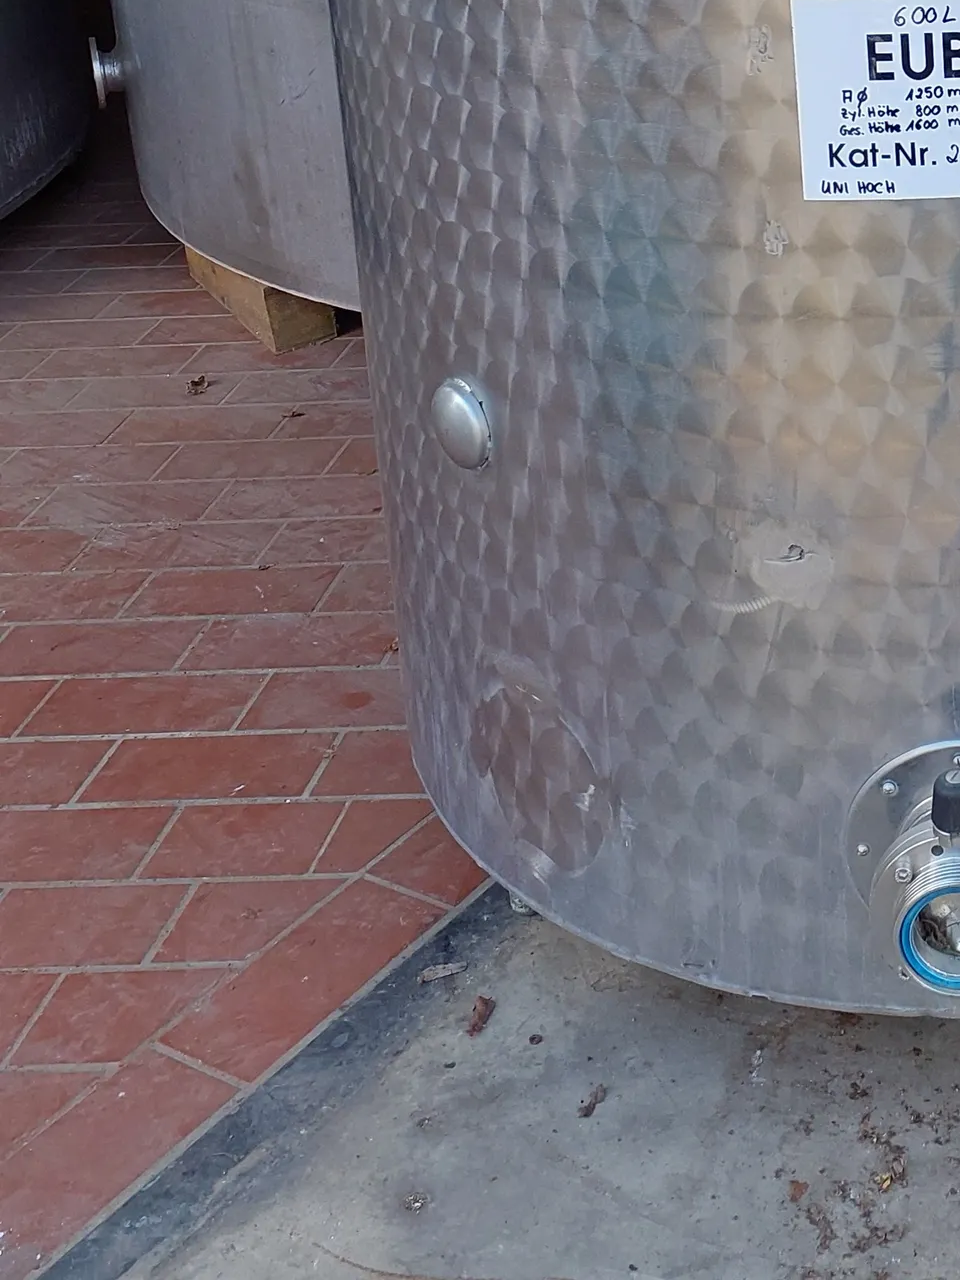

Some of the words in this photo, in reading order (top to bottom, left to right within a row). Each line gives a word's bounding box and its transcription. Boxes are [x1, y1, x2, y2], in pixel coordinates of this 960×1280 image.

[905, 86, 944, 101] 1250
[915, 105, 941, 117] 800
[905, 120, 939, 132] 1600
[828, 142, 938, 168] Kat-Nr.
[857, 180, 895, 194] HOCH
